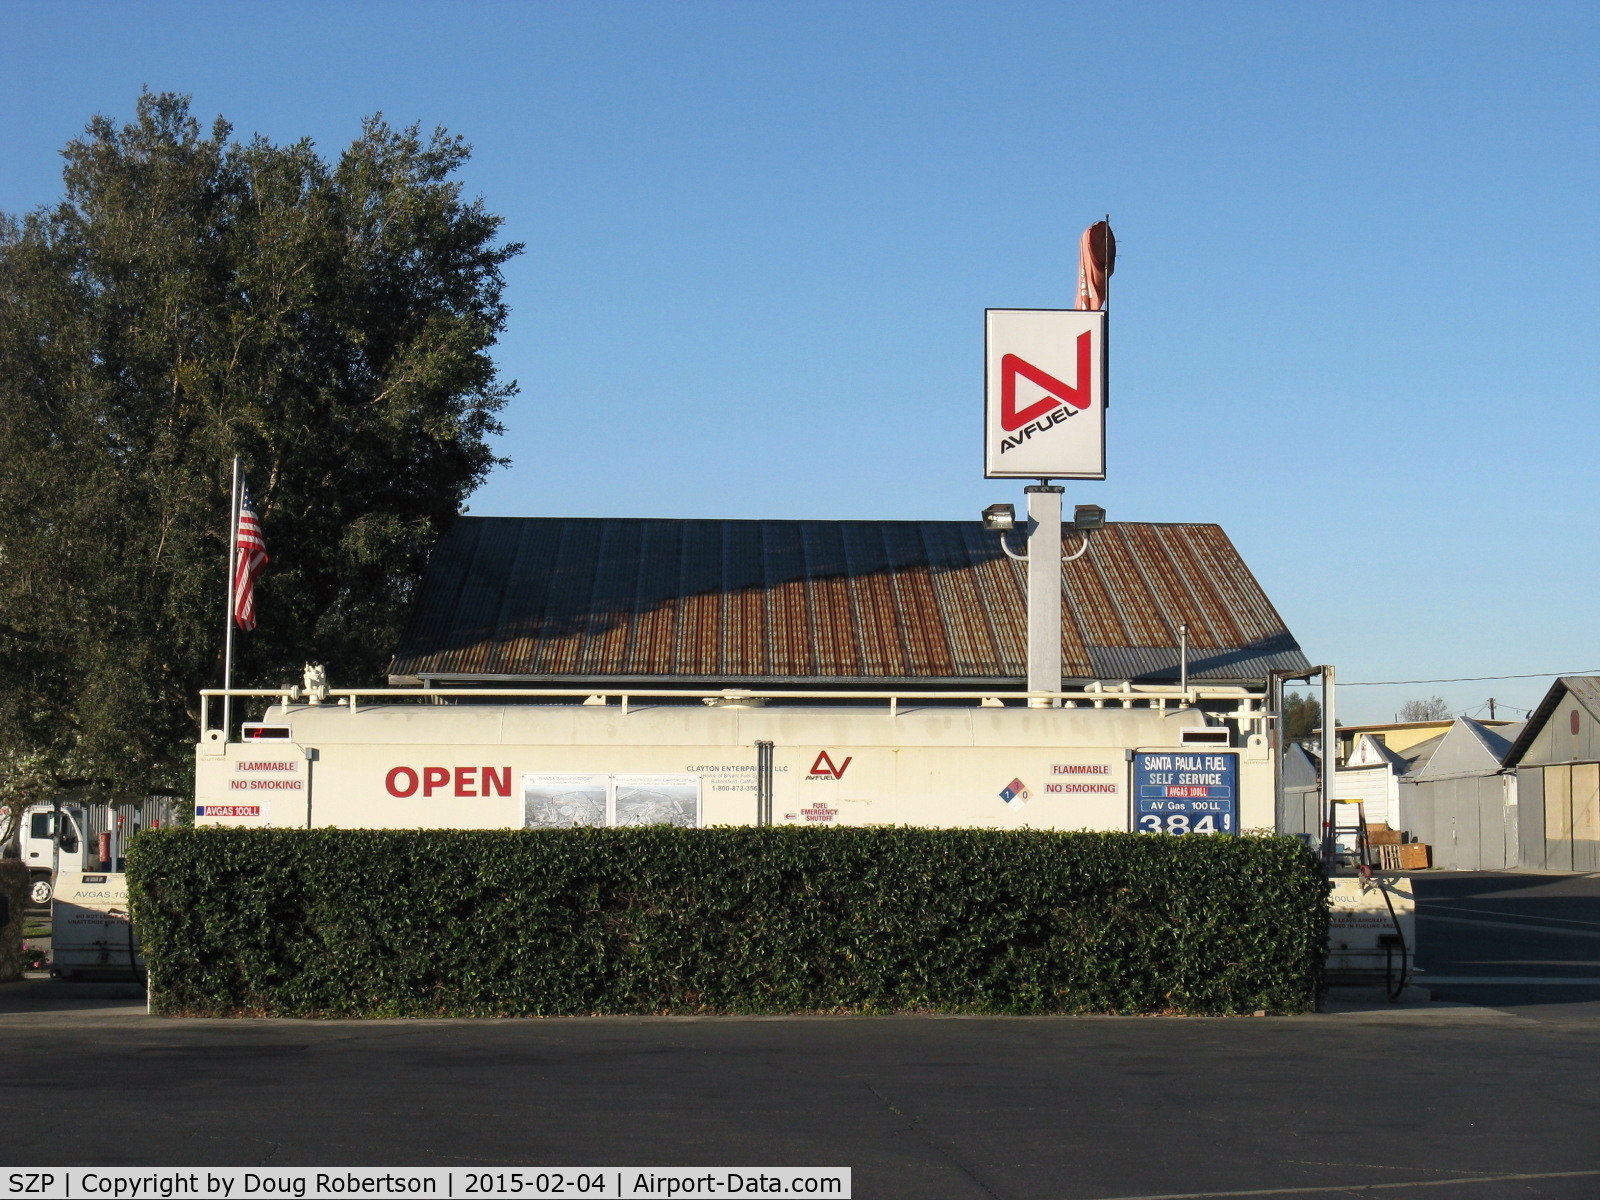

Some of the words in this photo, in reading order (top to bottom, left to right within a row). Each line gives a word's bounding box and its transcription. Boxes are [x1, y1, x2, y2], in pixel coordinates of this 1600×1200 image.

[1000, 406, 1079, 454] AVFUEL
[238, 761, 295, 772] FLAMMABLE
[1144, 757, 1172, 771] SANTA
[1175, 757, 1202, 771] PAULA
[1205, 757, 1227, 771] FUEL
[1053, 765, 1109, 775] FLAMMABLE
[385, 766, 512, 798] OPEN
[1149, 773, 1174, 785] SELF
[1179, 773, 1222, 785] SERVICE
[231, 780, 247, 790] NO
[250, 780, 302, 790] SMOKING
[1014, 782, 1019, 791] 3
[1046, 784, 1062, 793] NO
[1065, 784, 1116, 793] SMOKING
[1169, 787, 1188, 797] AVGAS
[1189, 787, 1207, 797] 100LL
[206, 806, 234, 816] AVGAS
[235, 806, 259, 816] 100LL
[812, 802, 828, 810] FUEL
[1150, 802, 1164, 810] AV
[1168, 802, 1185, 811] Gas
